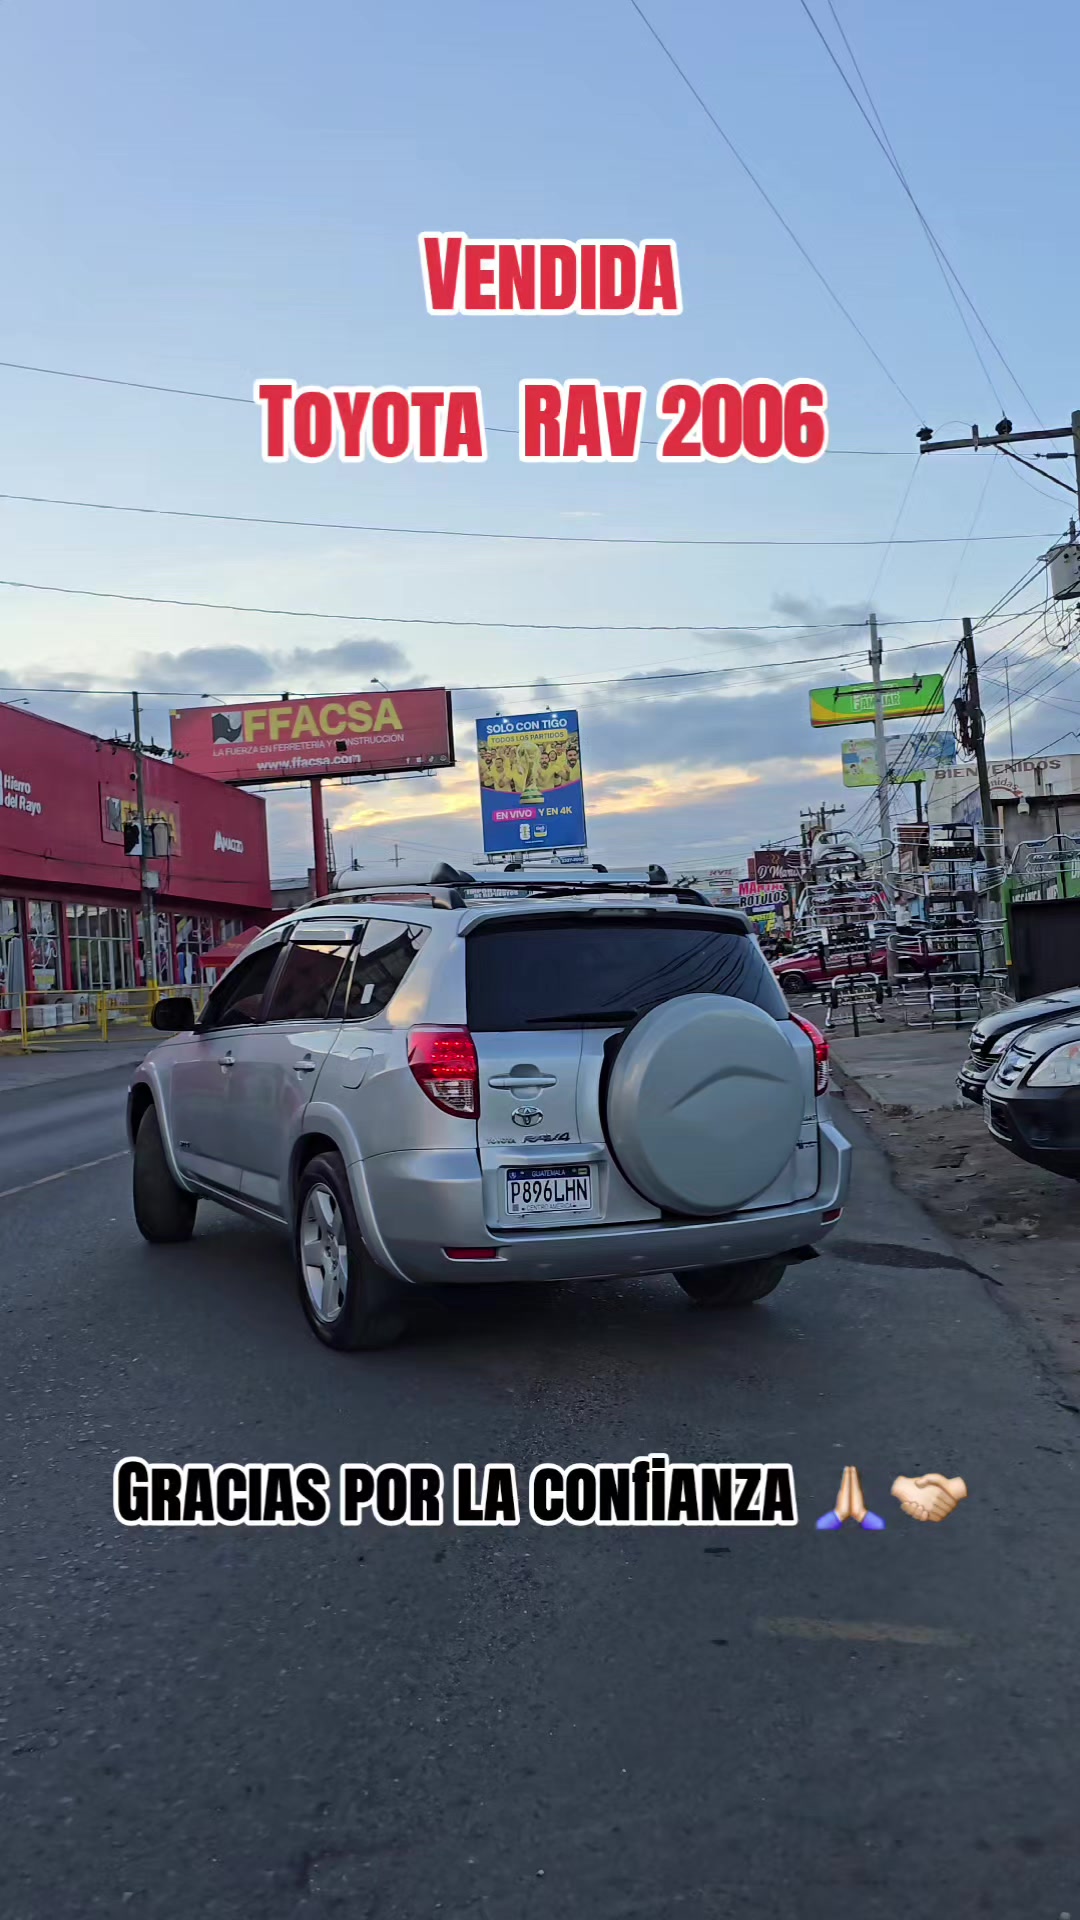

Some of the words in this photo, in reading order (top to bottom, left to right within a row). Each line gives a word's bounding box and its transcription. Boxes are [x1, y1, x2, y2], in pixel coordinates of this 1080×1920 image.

[243, 698, 403, 743] FFACSA
[486, 723, 514, 734] SOLO
[516, 721, 540, 731] CON
[541, 718, 567, 729] TIGO
[491, 736, 515, 744] TODOS
[516, 734, 529, 742] LOS
[530, 732, 564, 741] PARTIDOS
[213, 748, 224, 757] LA
[225, 746, 258, 756] FUERZA
[260, 745, 272, 753] EN
[273, 739, 325, 752] FERRETERÍA
[327, 740, 332, 748] Y
[257, 754, 361, 770] www.ffacsa.com
[3, 774, 31, 794] Hierro
[4, 792, 18, 808] del
[19, 796, 42, 816] Rayo
[496, 812, 509, 820] EN
[509, 810, 532, 819] VIVO
[538, 808, 545, 816] Y
[546, 807, 559, 816] EN
[559, 806, 573, 815] 4K
[522, 1132, 571, 1143] RAV4
[531, 1169, 566, 1178] GUATEMALA
[511, 1178, 588, 1204] P896LHN
